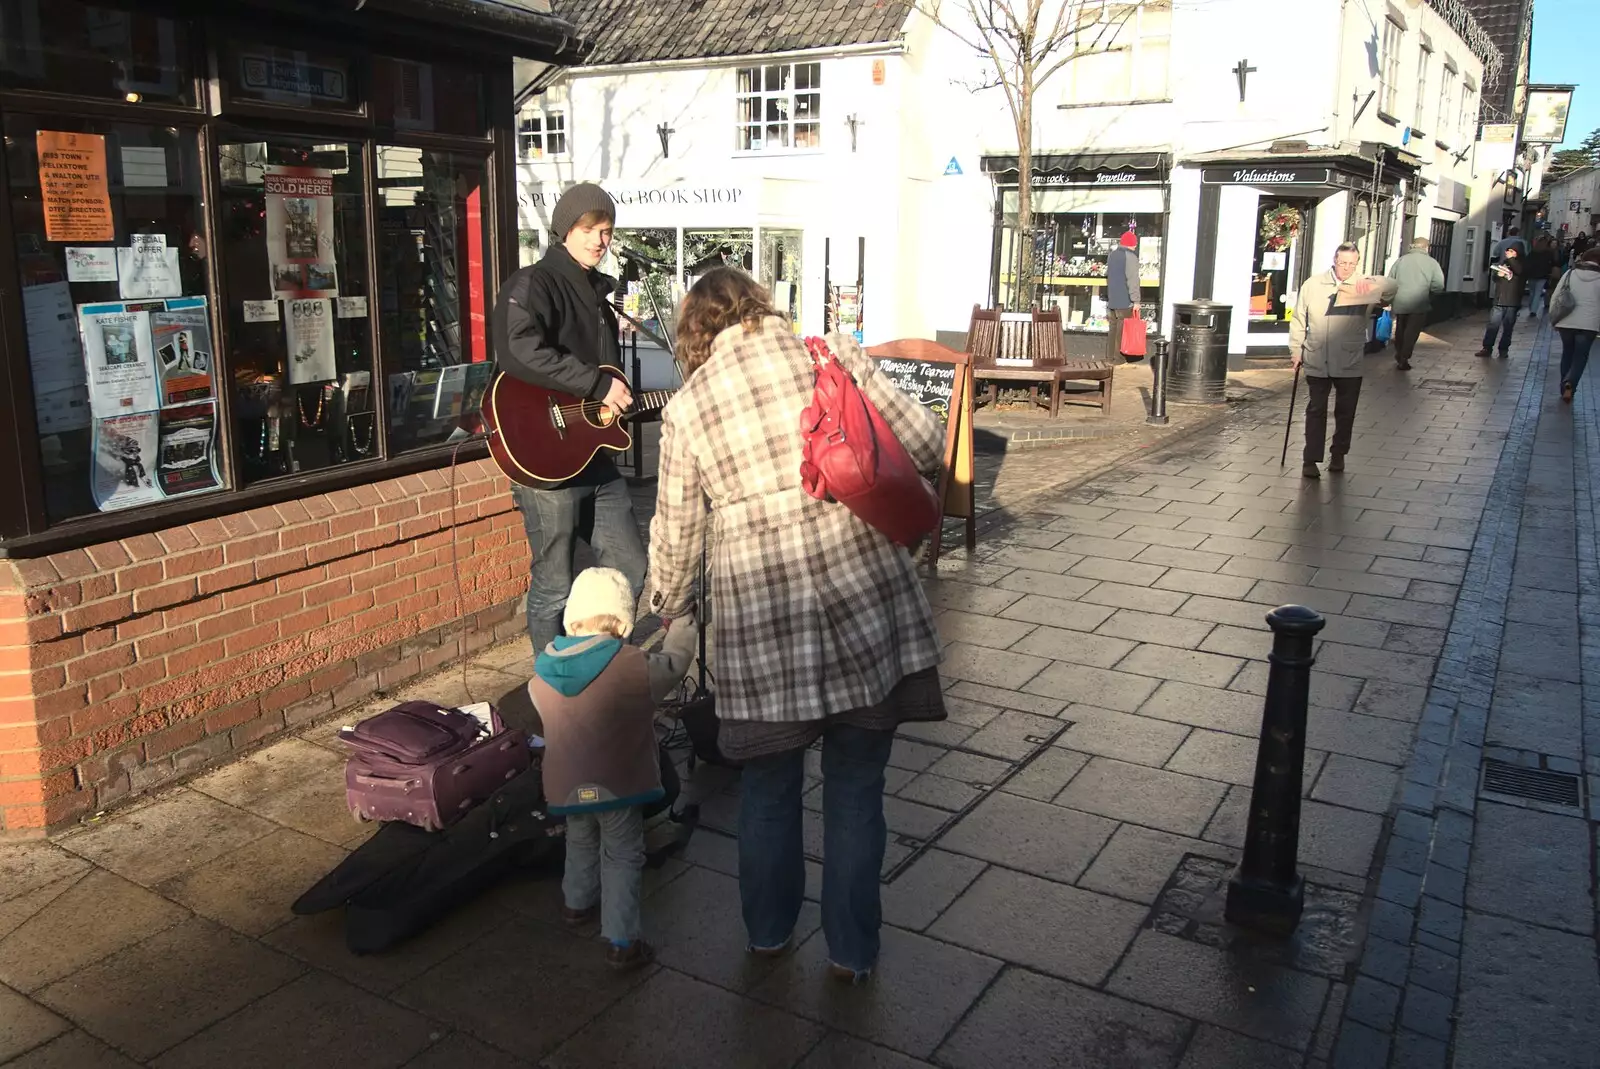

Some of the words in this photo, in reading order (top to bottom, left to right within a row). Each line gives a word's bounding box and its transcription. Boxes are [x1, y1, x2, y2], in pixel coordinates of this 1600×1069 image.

[43, 162, 89, 170] FELIXSTOWE
[52, 172, 82, 180] WALTON
[1031, 172, 1070, 184] emstock's
[1096, 172, 1137, 183] Jewellers
[1232, 169, 1296, 182] Valuations
[280, 177, 313, 185] CHRISTMAS
[266, 182, 297, 194] SOLD
[298, 184, 333, 196] HERE!
[637, 189, 689, 206] BOOK
[693, 187, 742, 203] SHOP
[131, 235, 164, 244] SPECIAL
[137, 245, 163, 254] OFFER
[114, 315, 138, 324] FISHER
